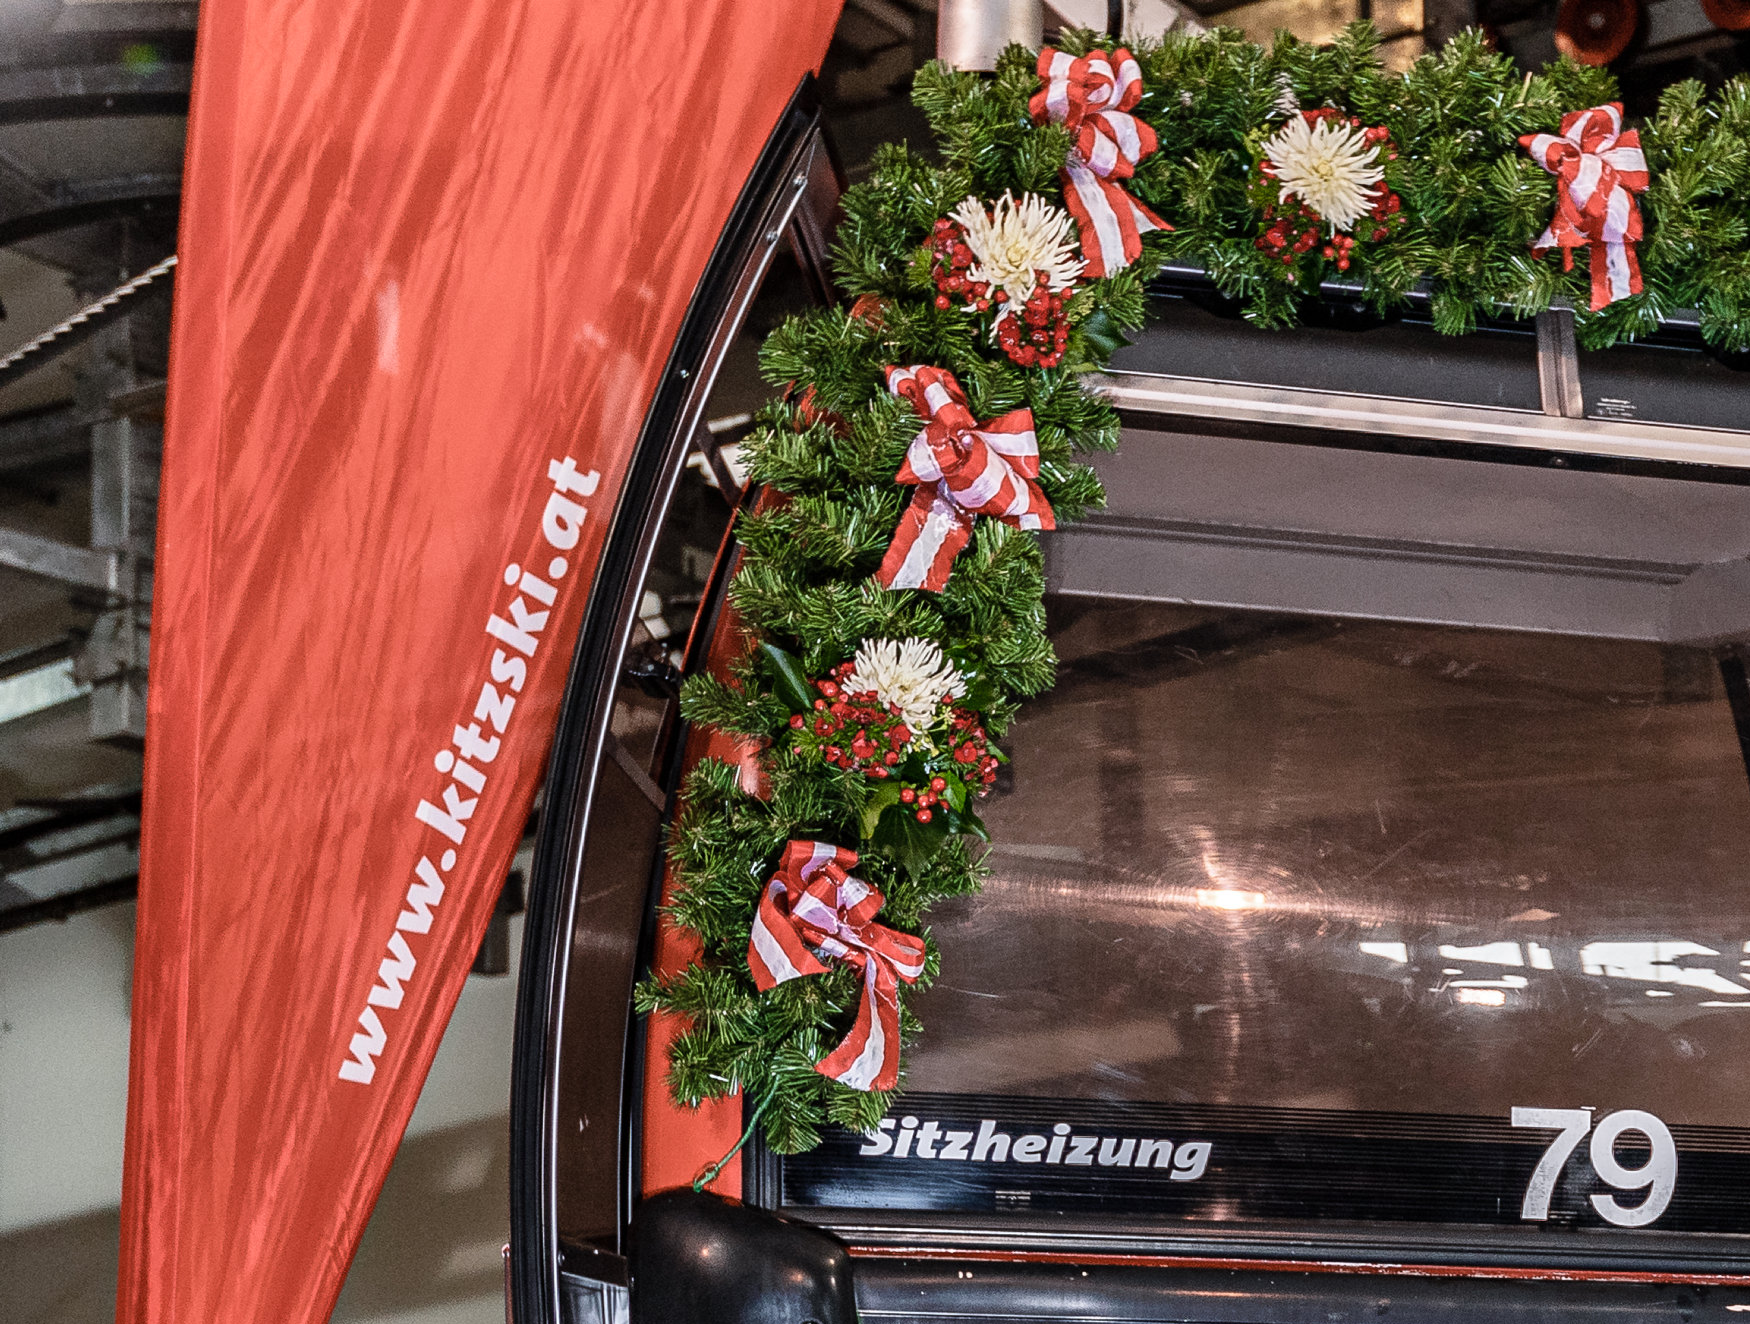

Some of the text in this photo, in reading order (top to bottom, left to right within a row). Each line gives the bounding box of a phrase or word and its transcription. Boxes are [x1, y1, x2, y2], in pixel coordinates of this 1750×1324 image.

[338, 455, 601, 1085] www.kitzski.at
[859, 1115, 1212, 1181] Sitzheizung
[1511, 1106, 1678, 1227] 79
